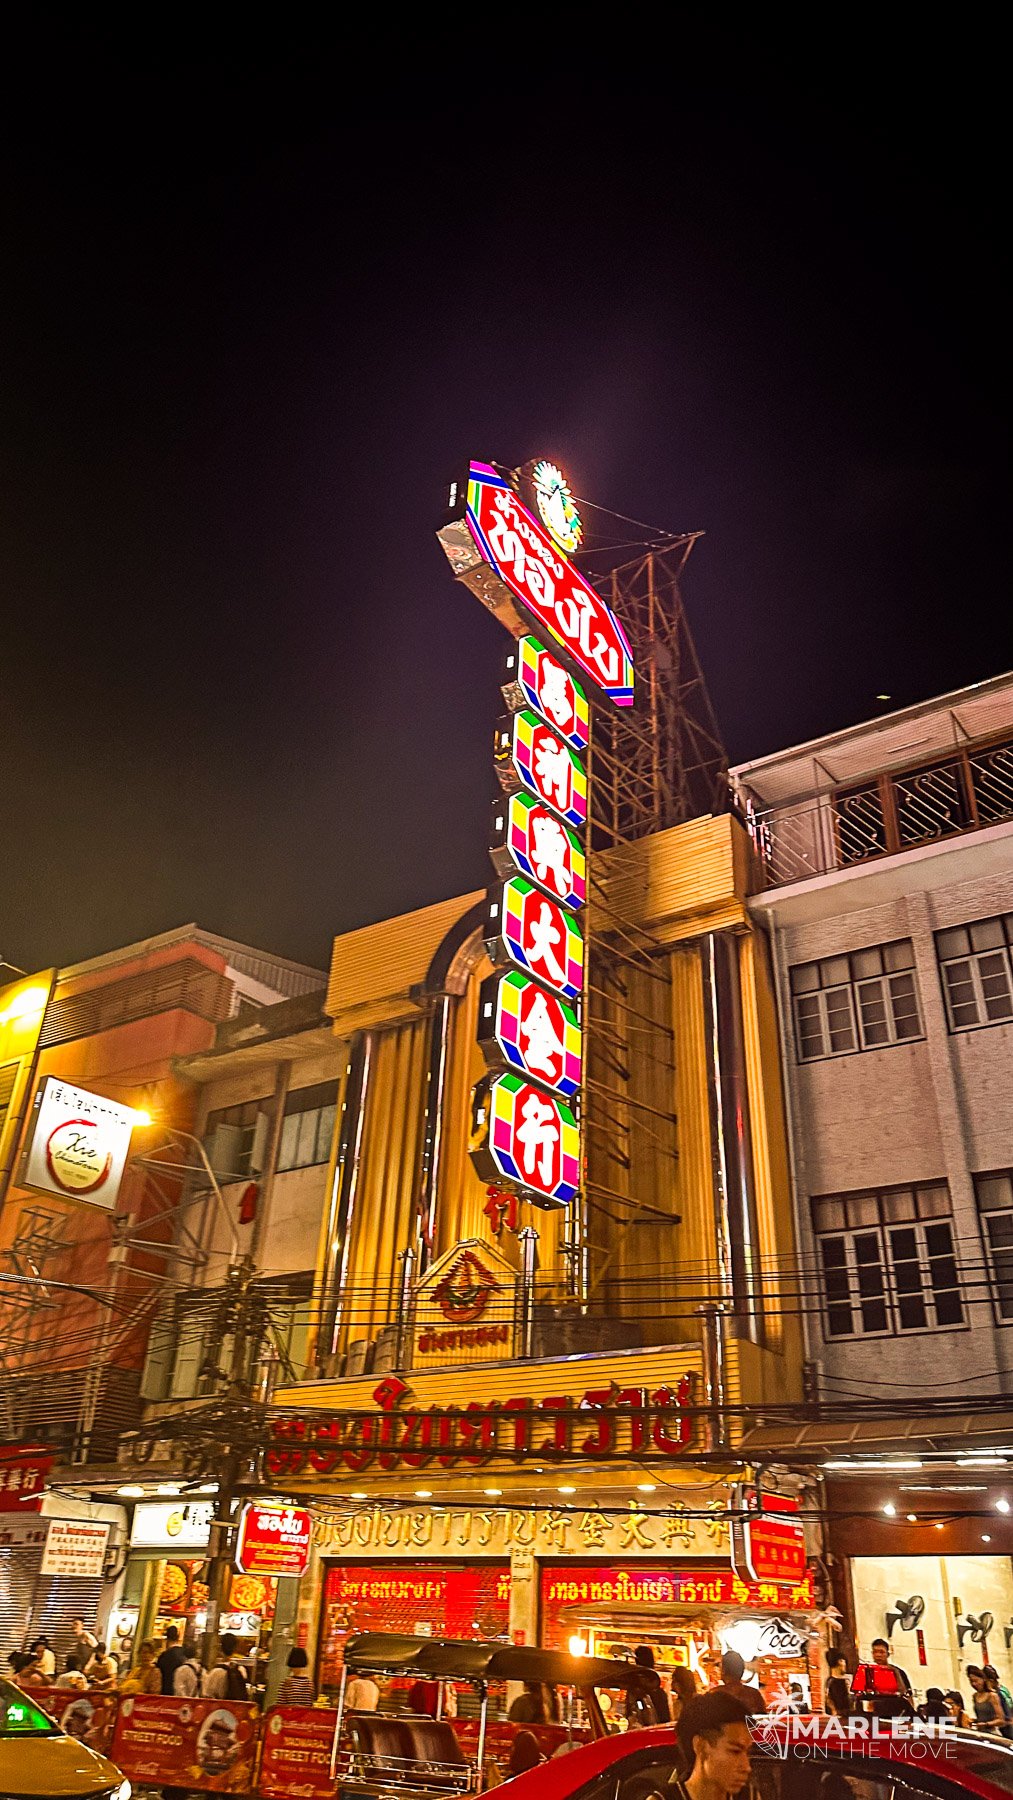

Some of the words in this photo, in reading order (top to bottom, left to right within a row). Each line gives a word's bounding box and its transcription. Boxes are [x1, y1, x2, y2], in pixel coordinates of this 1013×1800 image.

[488, 510, 619, 681] ทองใบ
[121, 1729, 156, 1743] STREET
[156, 1733, 183, 1746] FOOD
[271, 1748, 310, 1762] STREET
